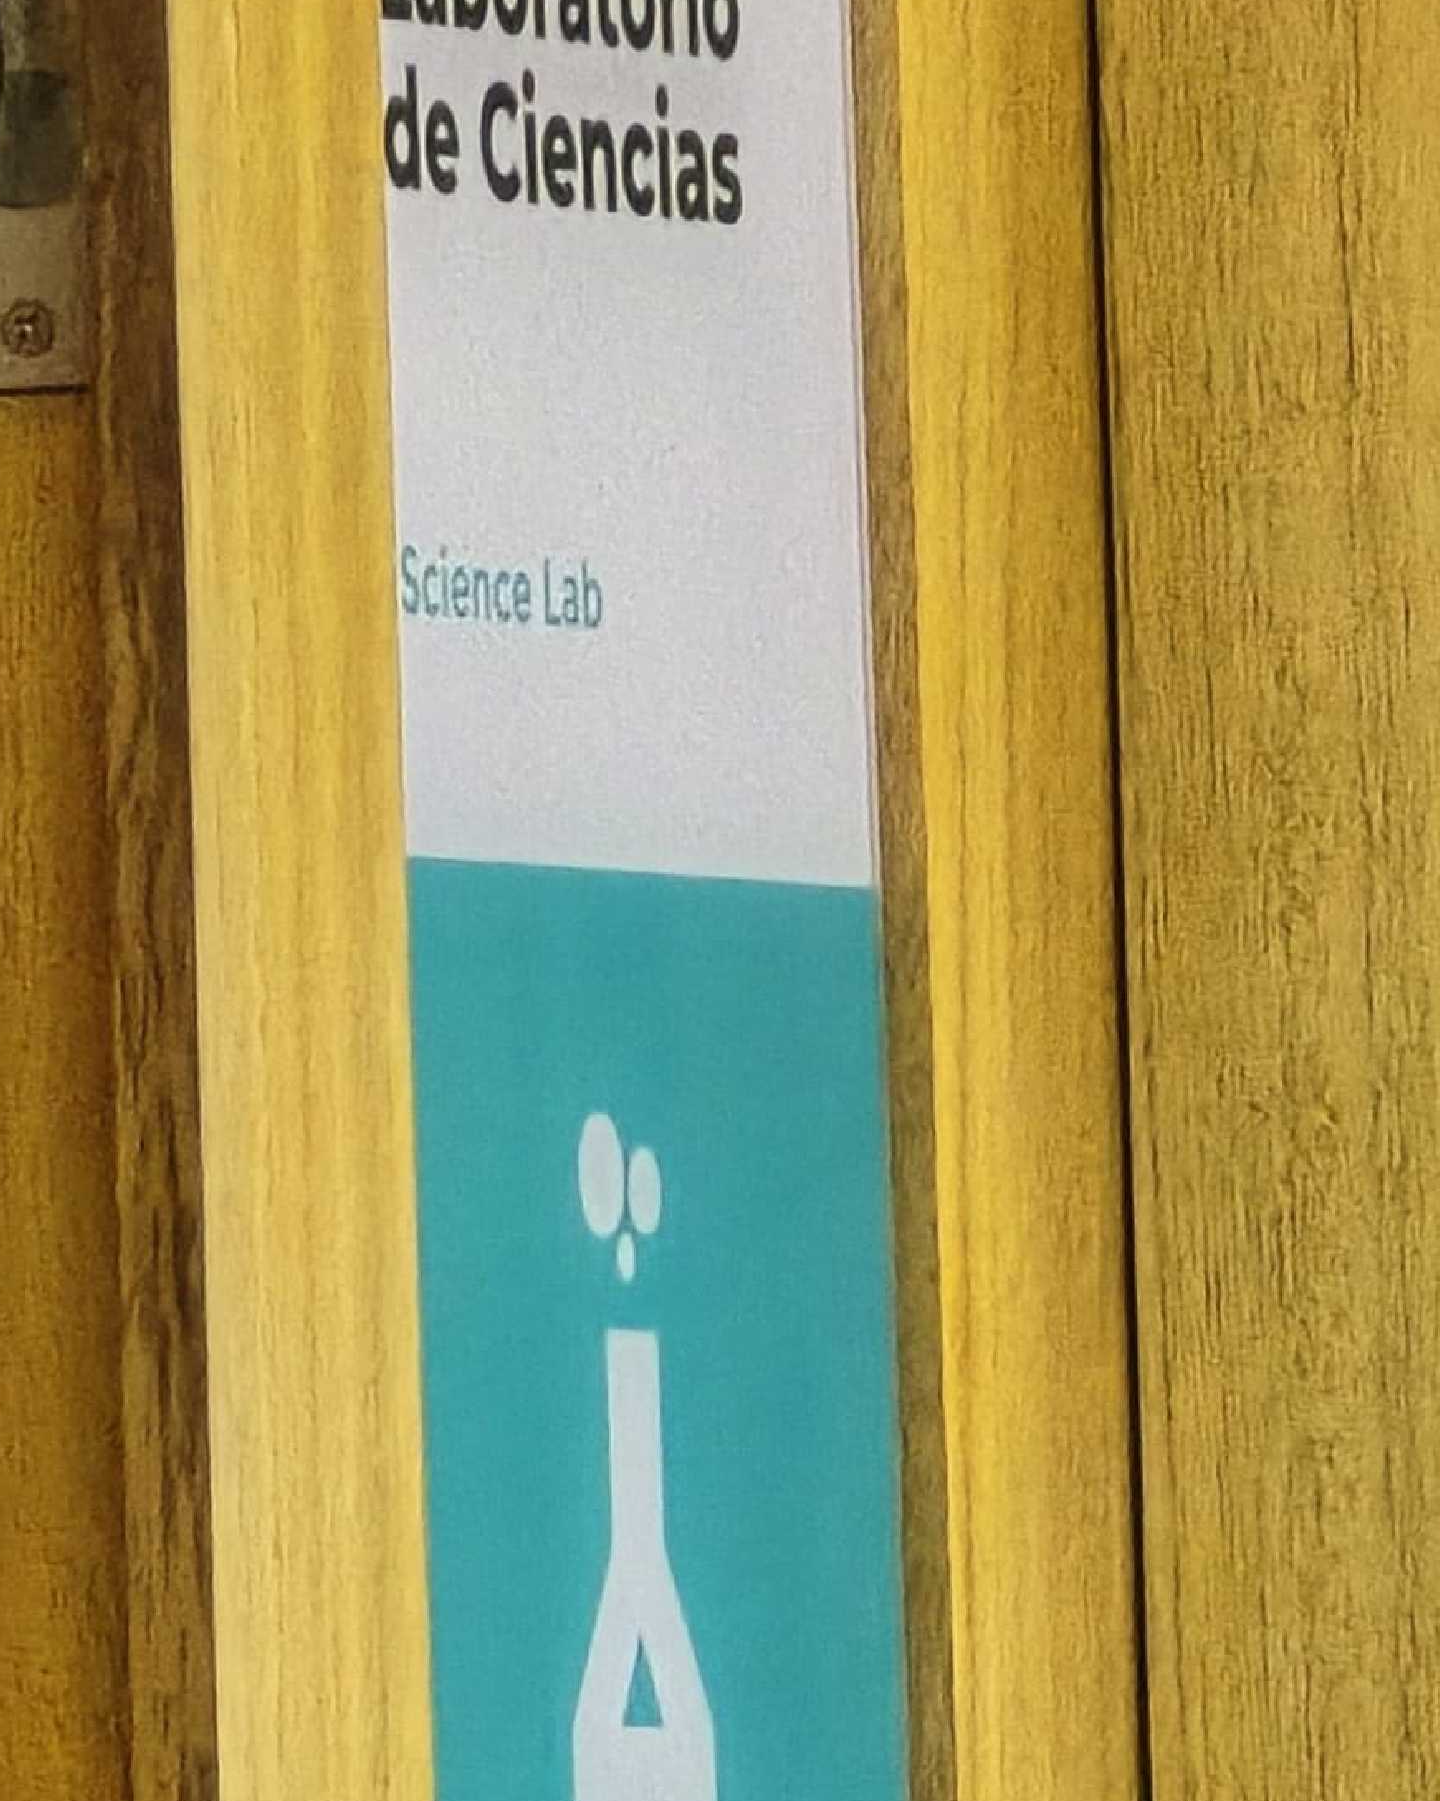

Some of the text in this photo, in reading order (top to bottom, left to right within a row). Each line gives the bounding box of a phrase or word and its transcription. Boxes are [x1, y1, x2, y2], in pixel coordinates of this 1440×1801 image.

[384, 63, 742, 224] de Ciencias
[401, 545, 602, 628] Science Lab
